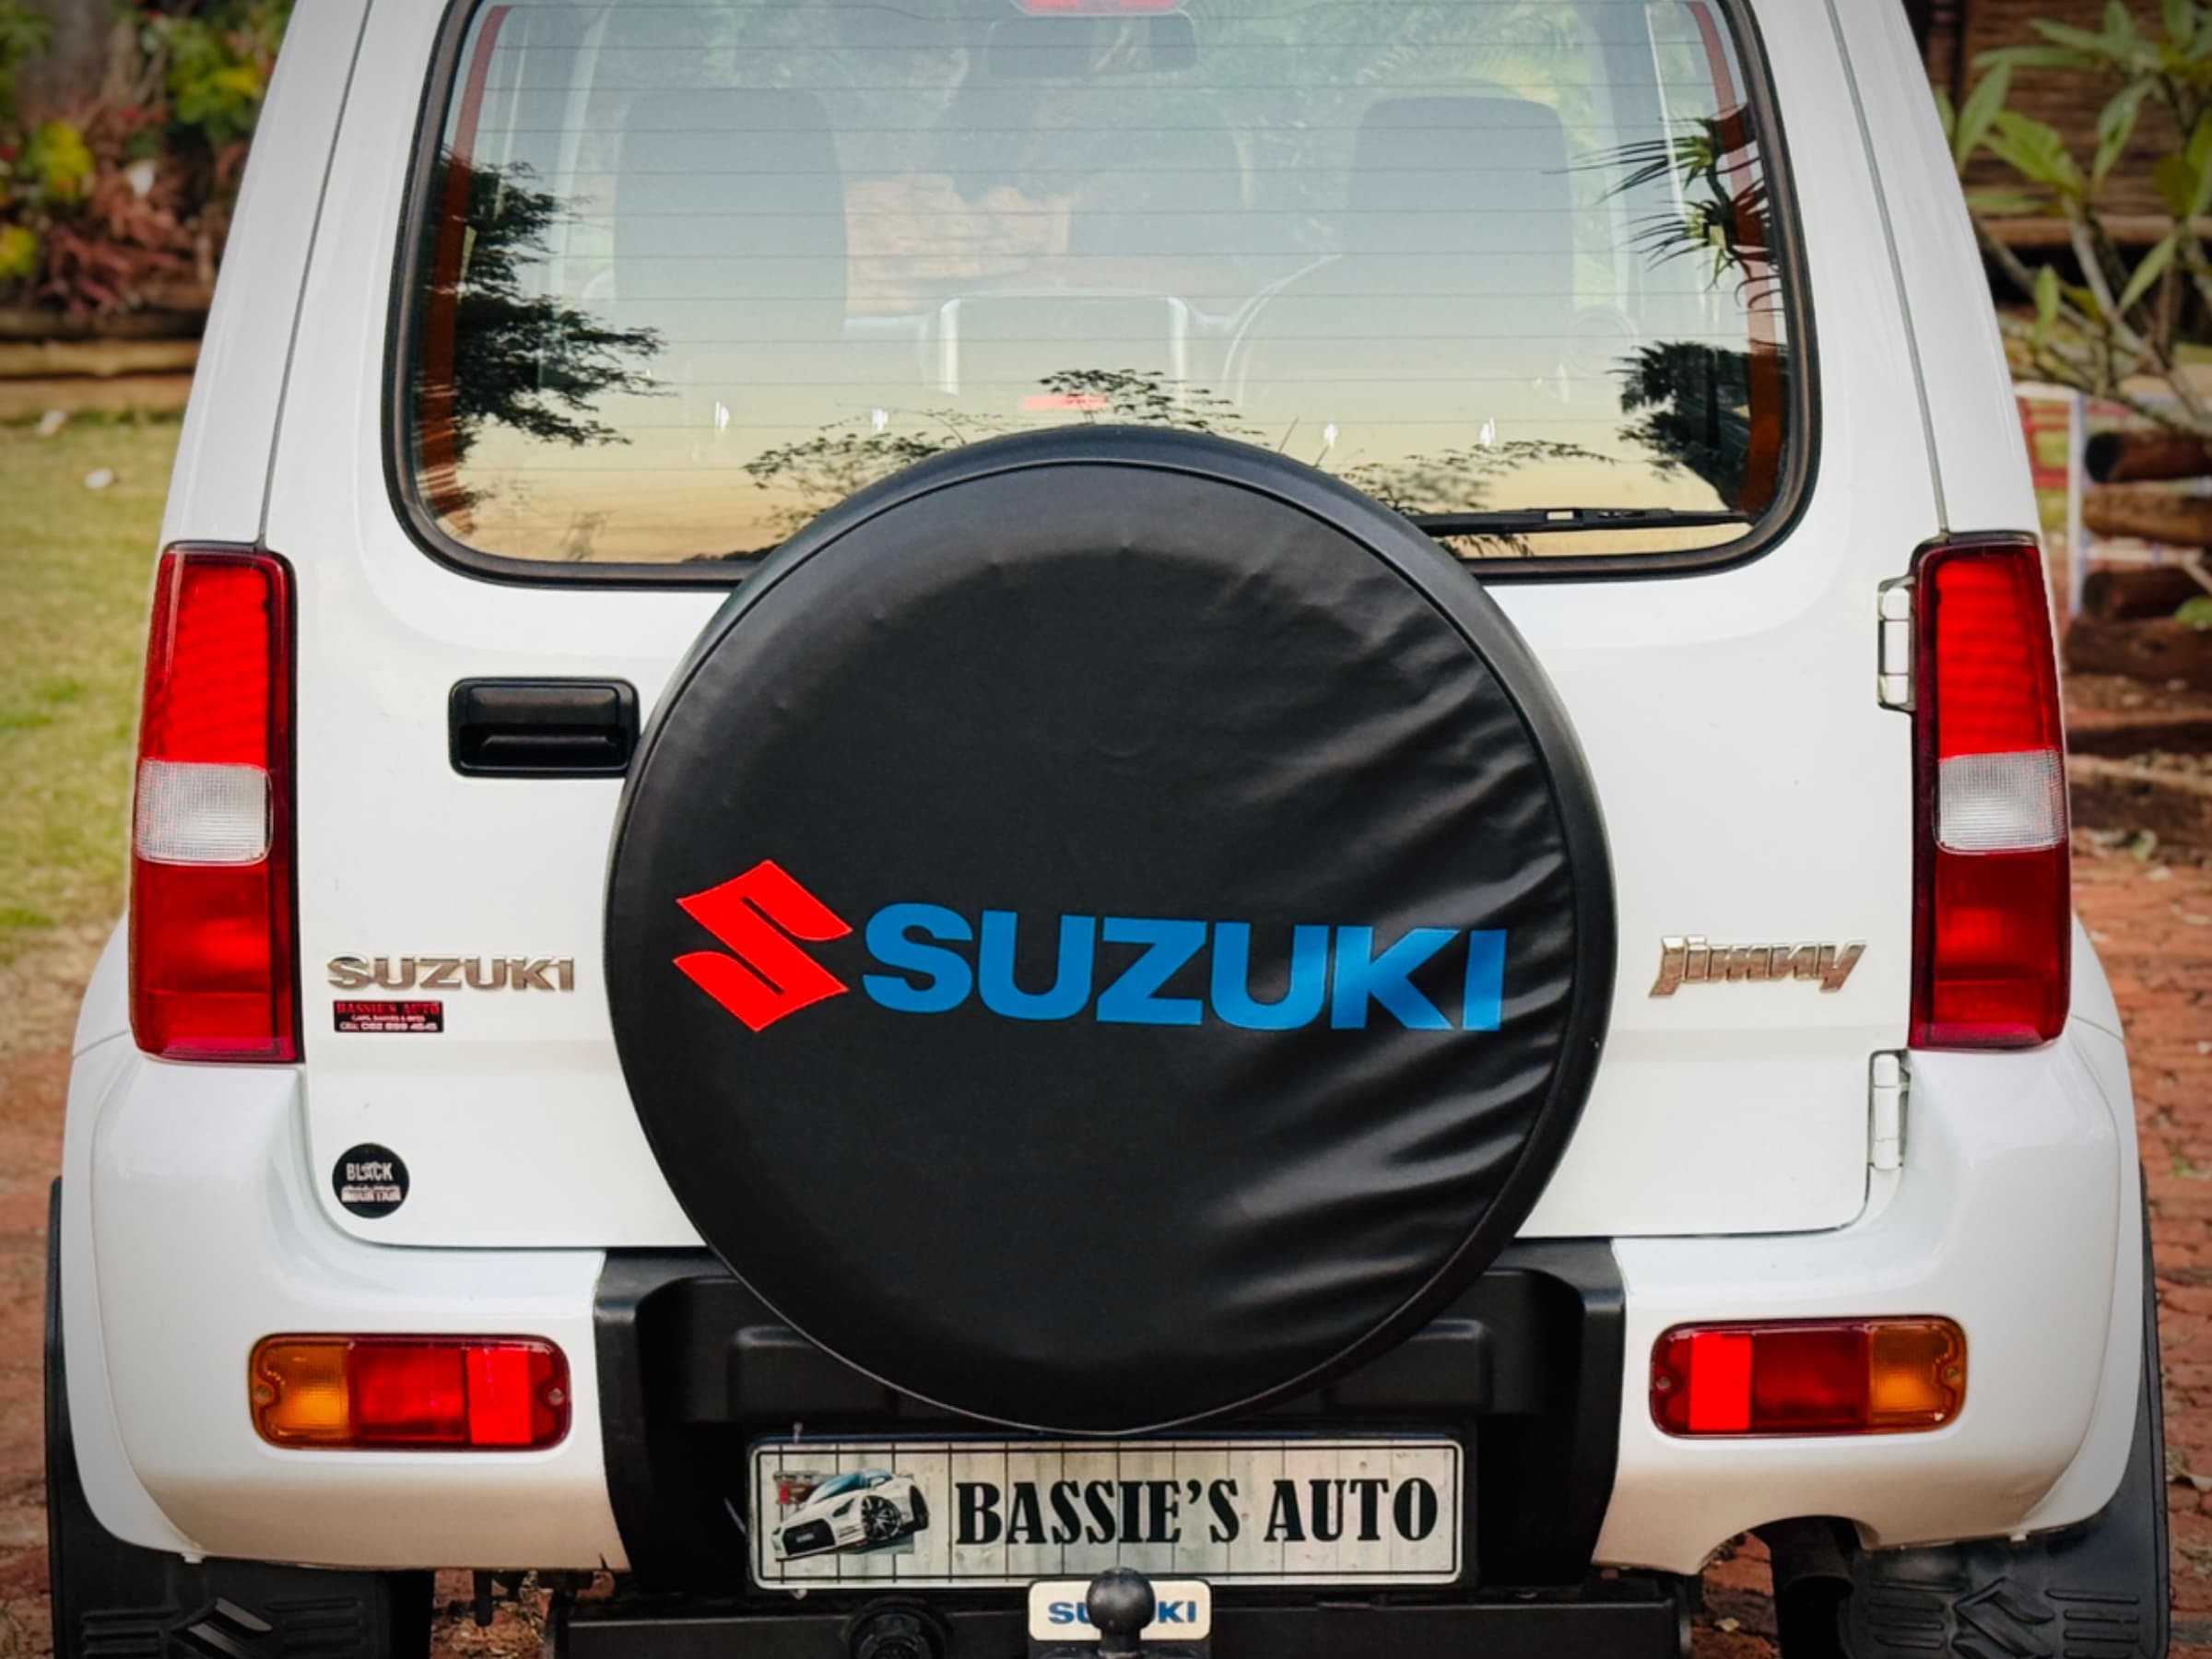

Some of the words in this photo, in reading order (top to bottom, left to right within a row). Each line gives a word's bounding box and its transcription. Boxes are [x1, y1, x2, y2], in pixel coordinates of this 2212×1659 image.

[327, 956, 575, 991] SUZUKI
[862, 902, 1507, 1032] SUZUKI
[955, 1479, 1241, 1545] BASSIE'S
[1264, 1477, 1439, 1542] AUTO
